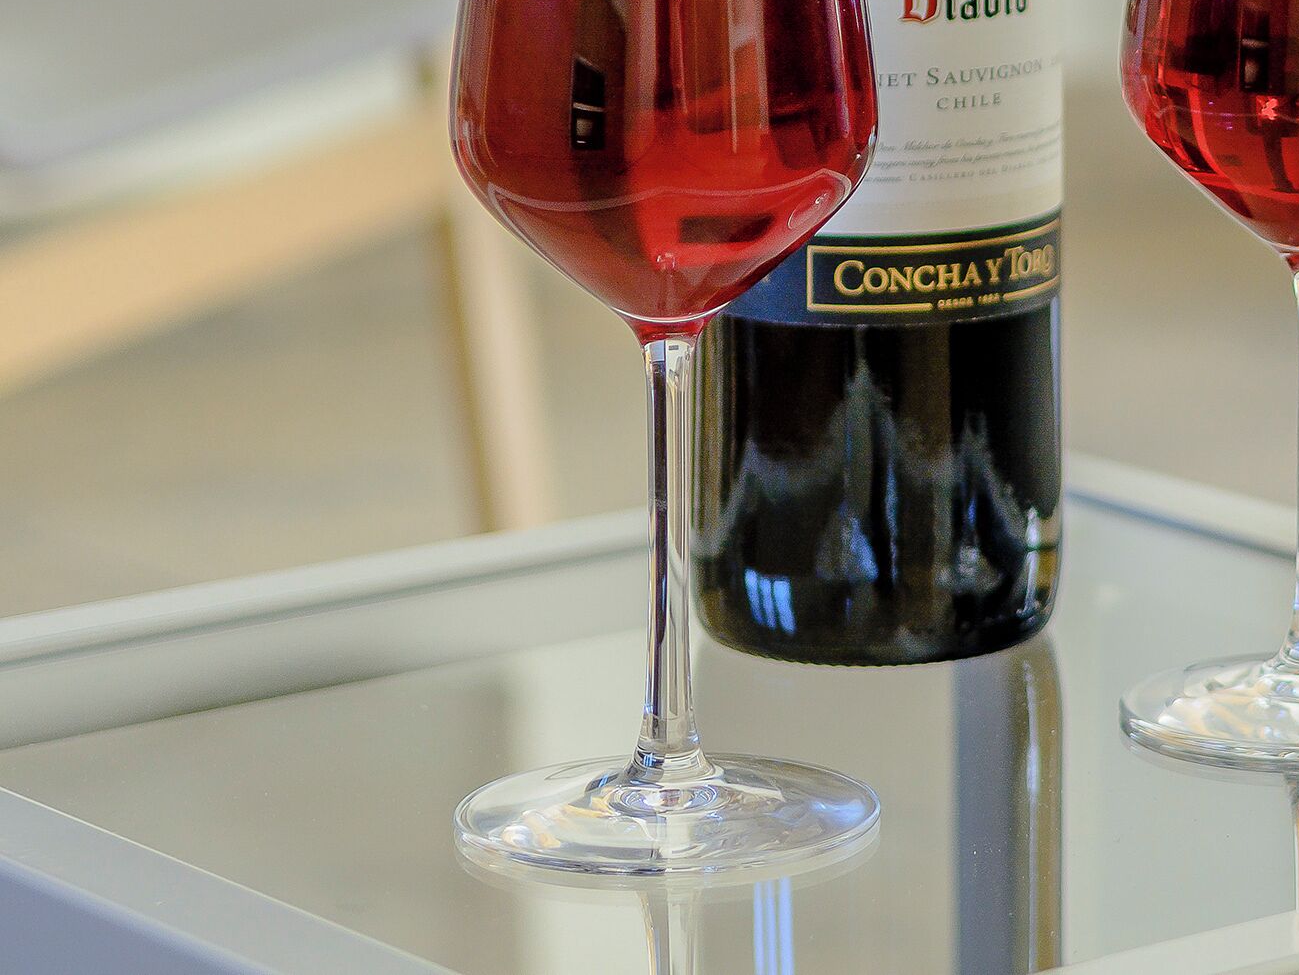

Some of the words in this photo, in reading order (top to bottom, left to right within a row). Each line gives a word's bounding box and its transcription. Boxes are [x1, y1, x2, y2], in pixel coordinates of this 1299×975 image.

[926, 58, 1043, 86] SAUVIGNON
[936, 92, 1003, 111] CHILE
[833, 259, 983, 296] CONCHA
[985, 257, 1003, 284] Y
